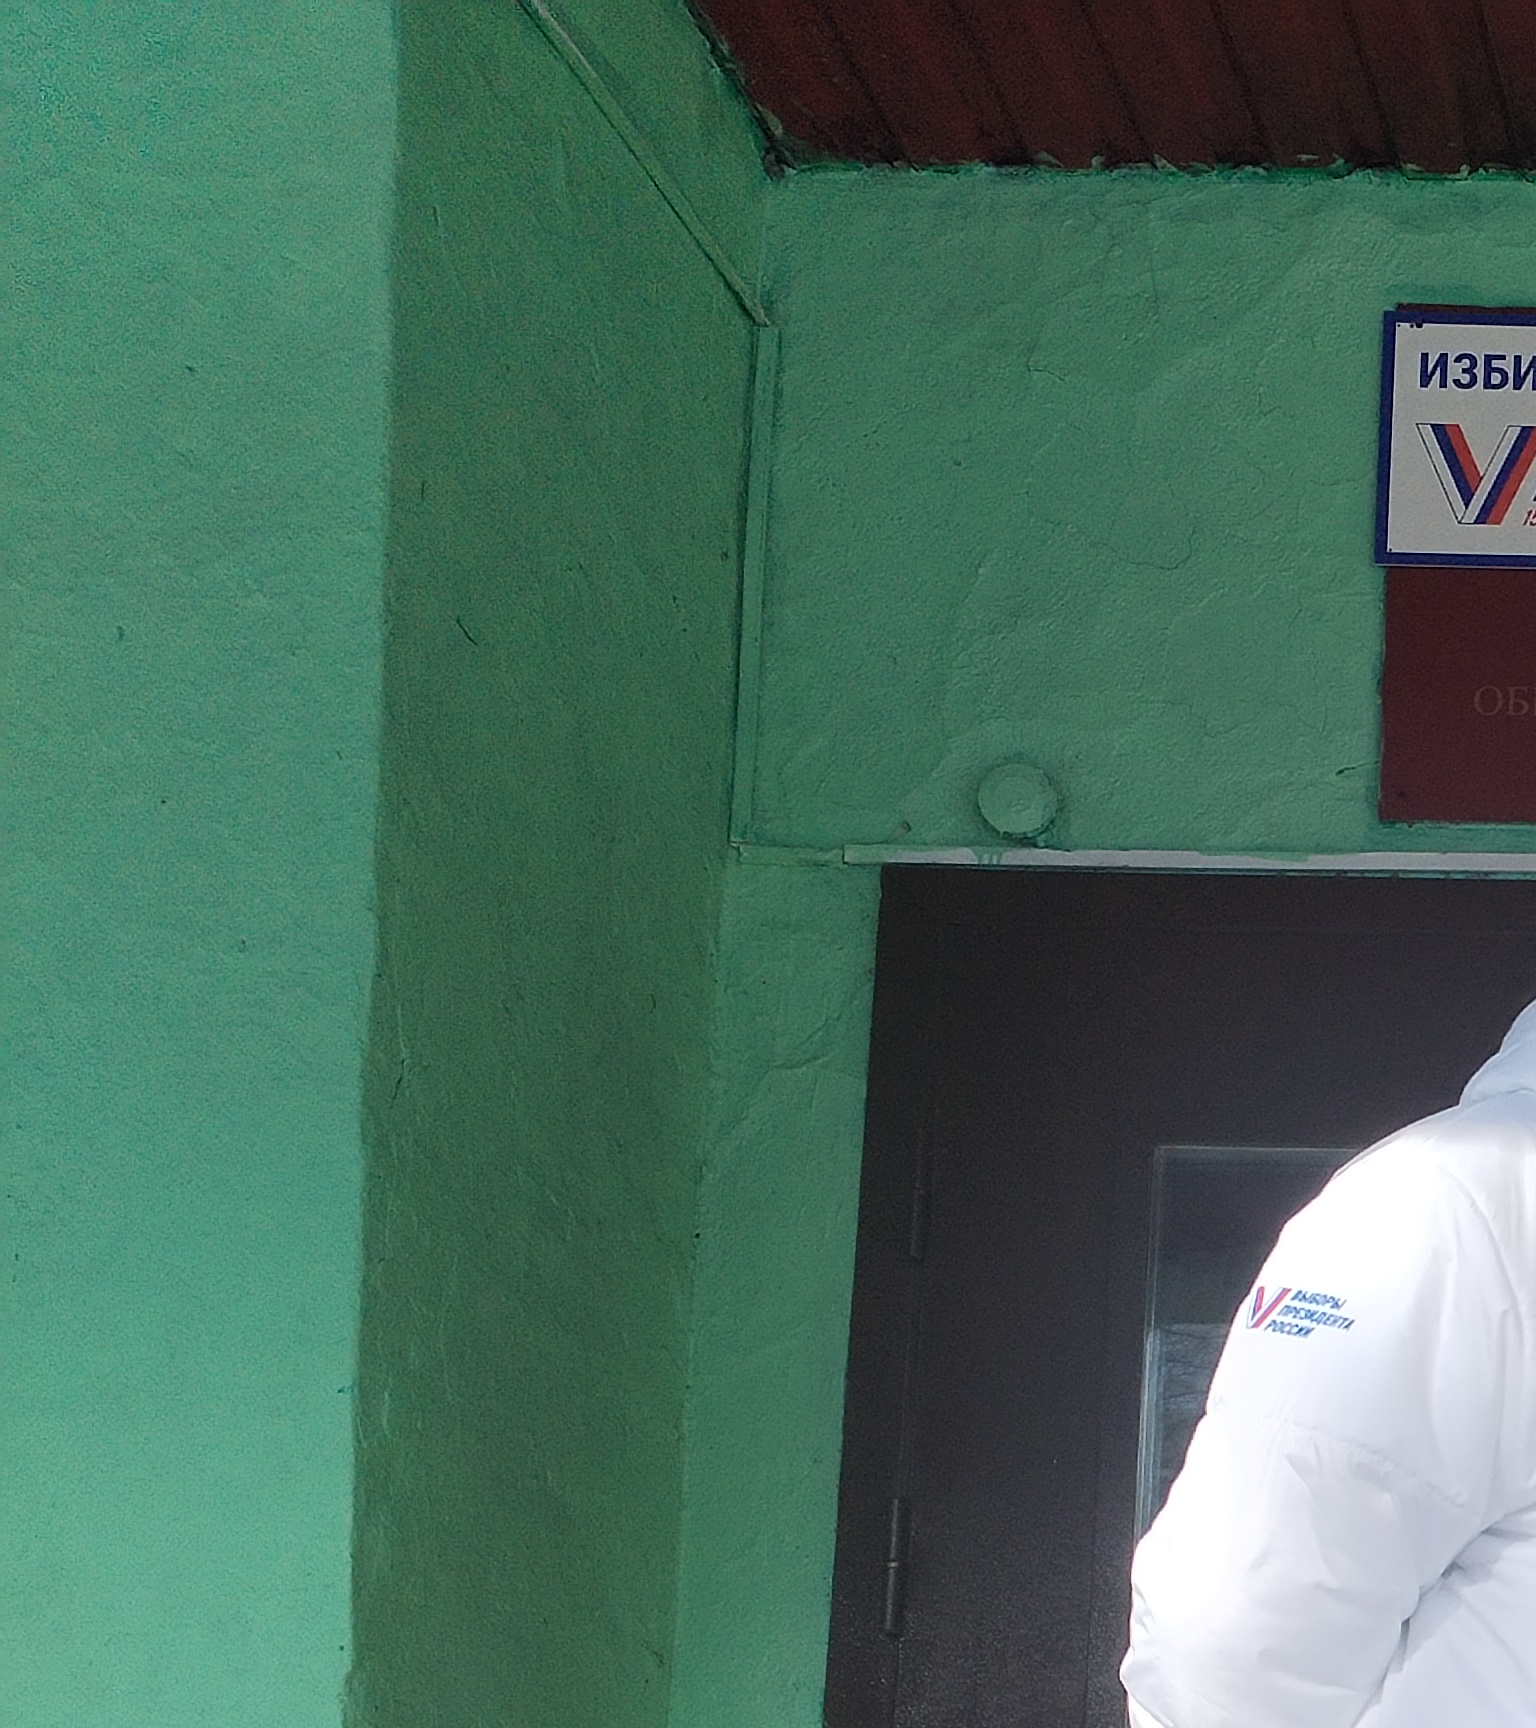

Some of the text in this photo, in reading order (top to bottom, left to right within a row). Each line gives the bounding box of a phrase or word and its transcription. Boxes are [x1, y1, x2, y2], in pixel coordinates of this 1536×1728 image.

[1290, 1290, 1347, 1311] ВЫБОРЫ
[1277, 1304, 1355, 1331] ПРЕЗИДЕНТА
[1264, 1319, 1315, 1338] РОССИИ
